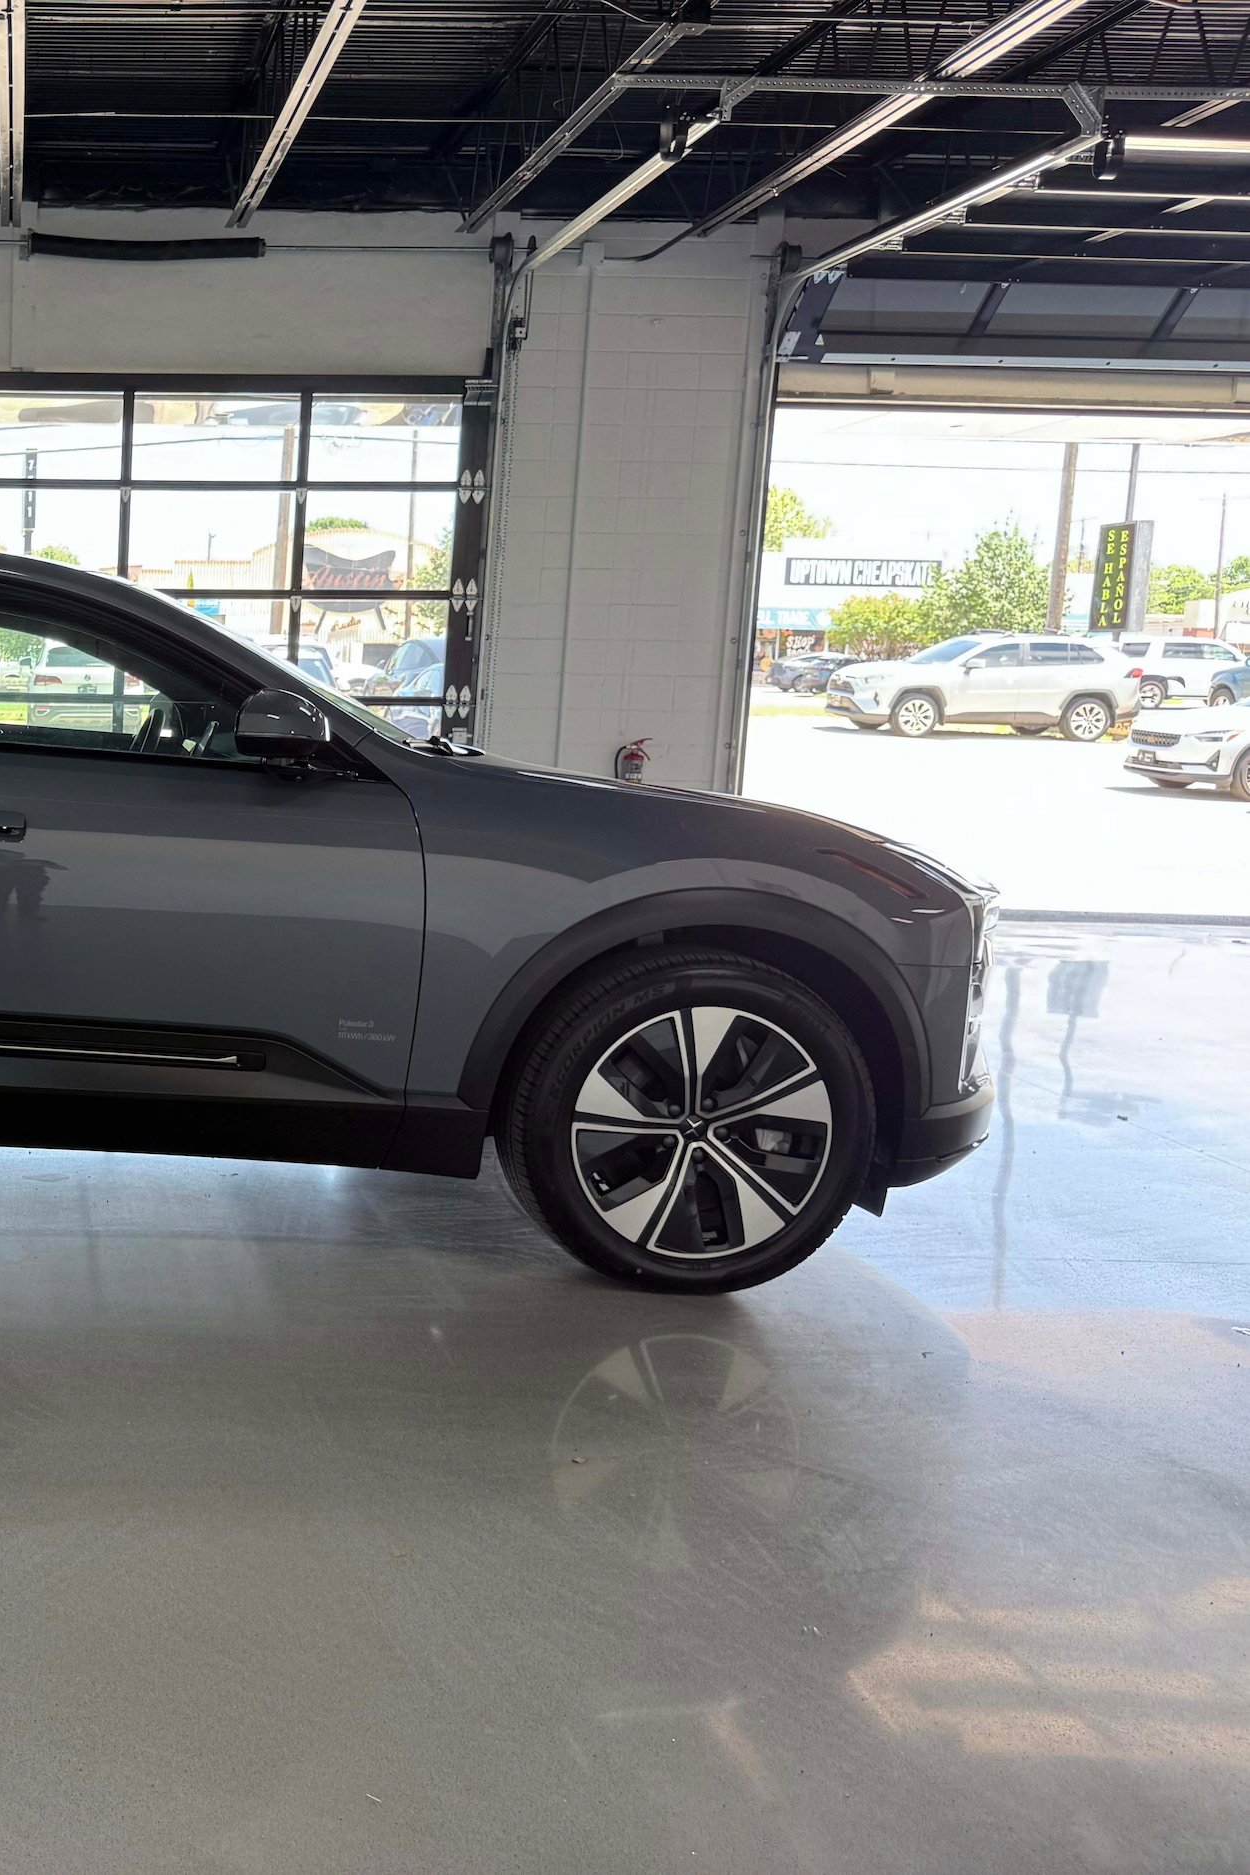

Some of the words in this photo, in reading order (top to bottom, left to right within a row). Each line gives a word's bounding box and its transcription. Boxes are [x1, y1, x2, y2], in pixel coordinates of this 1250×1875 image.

[1106, 529, 1115, 555] SE
[790, 559, 852, 585] UPTOWN
[1098, 562, 1114, 627] HABLA
[1112, 530, 1129, 624] ESPAÑOL
